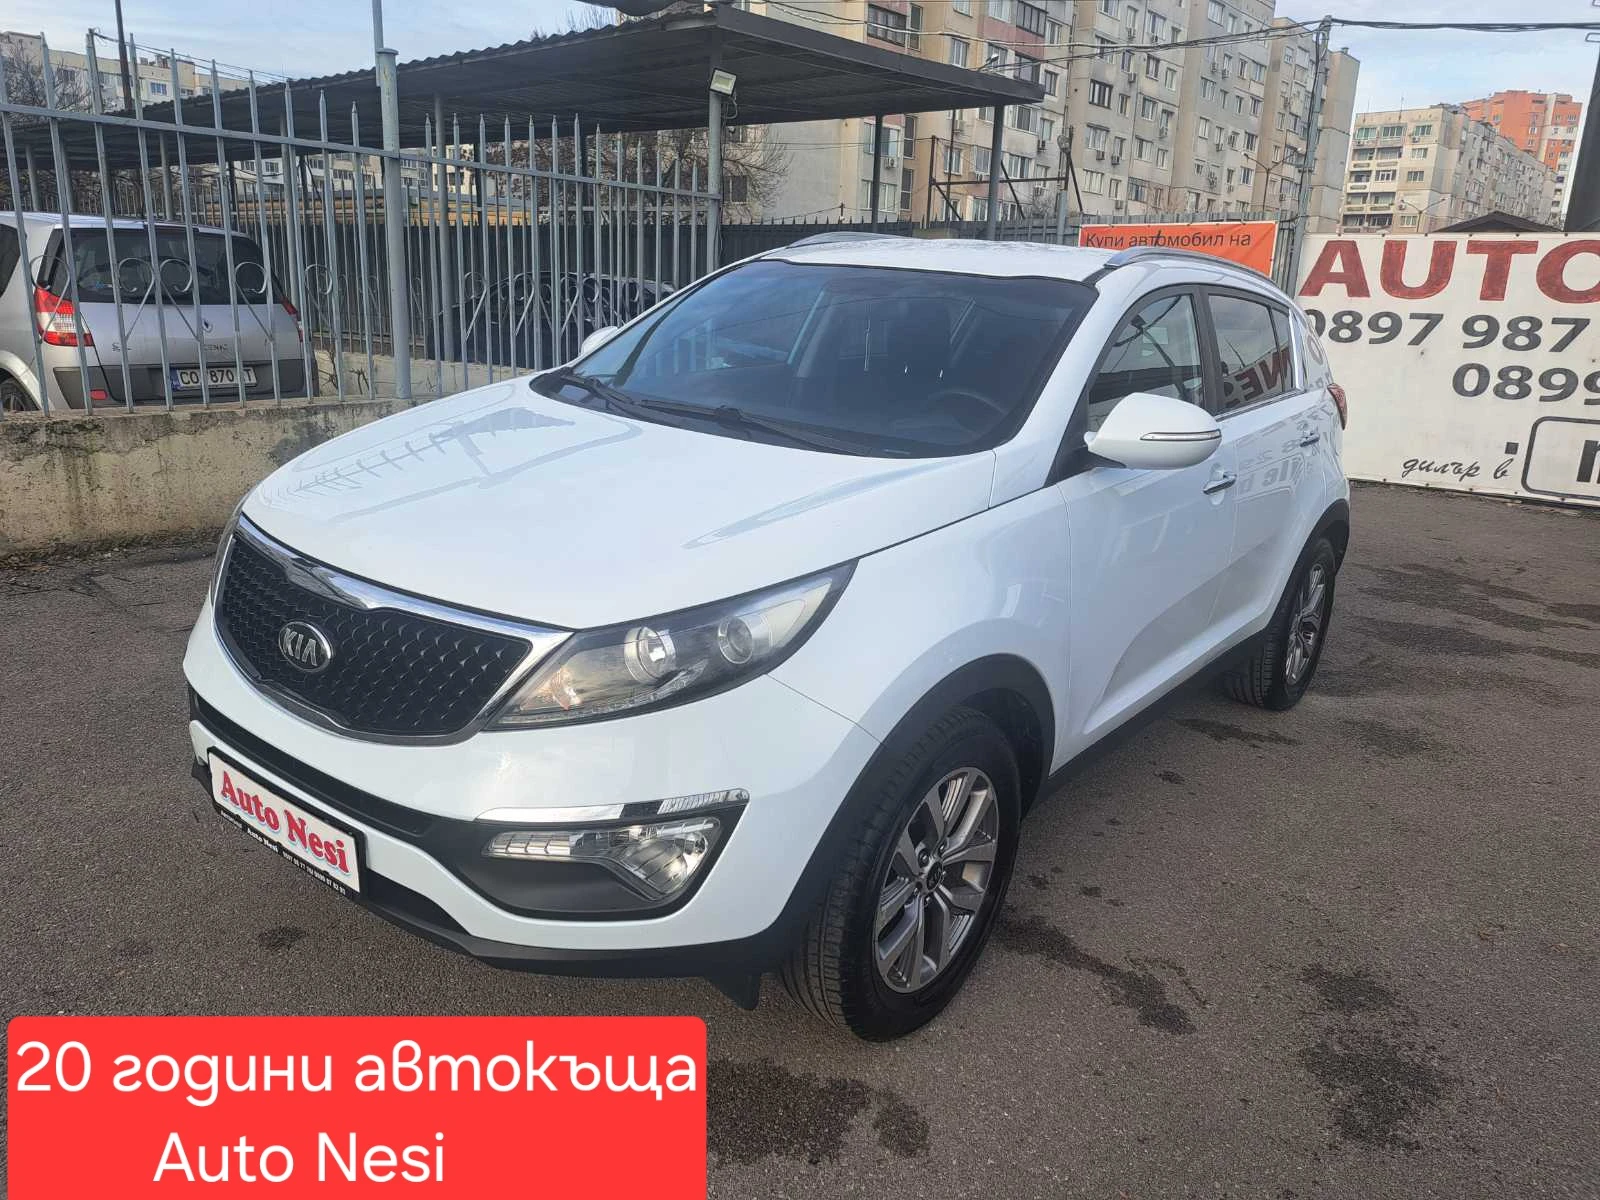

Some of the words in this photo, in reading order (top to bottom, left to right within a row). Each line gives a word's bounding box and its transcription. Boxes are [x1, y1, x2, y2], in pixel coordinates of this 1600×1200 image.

[1086, 232, 1124, 247] Купи
[1129, 231, 1223, 247] автомобил
[1229, 233, 1251, 247] на
[1298, 239, 1600, 304] AUTO
[1462, 314, 1591, 352] 987
[203, 369, 235, 383] 870
[1401, 458, 1481, 482] дилър
[283, 628, 317, 667] KIA
[221, 771, 280, 831] Auto
[284, 809, 350, 874] Nesi
